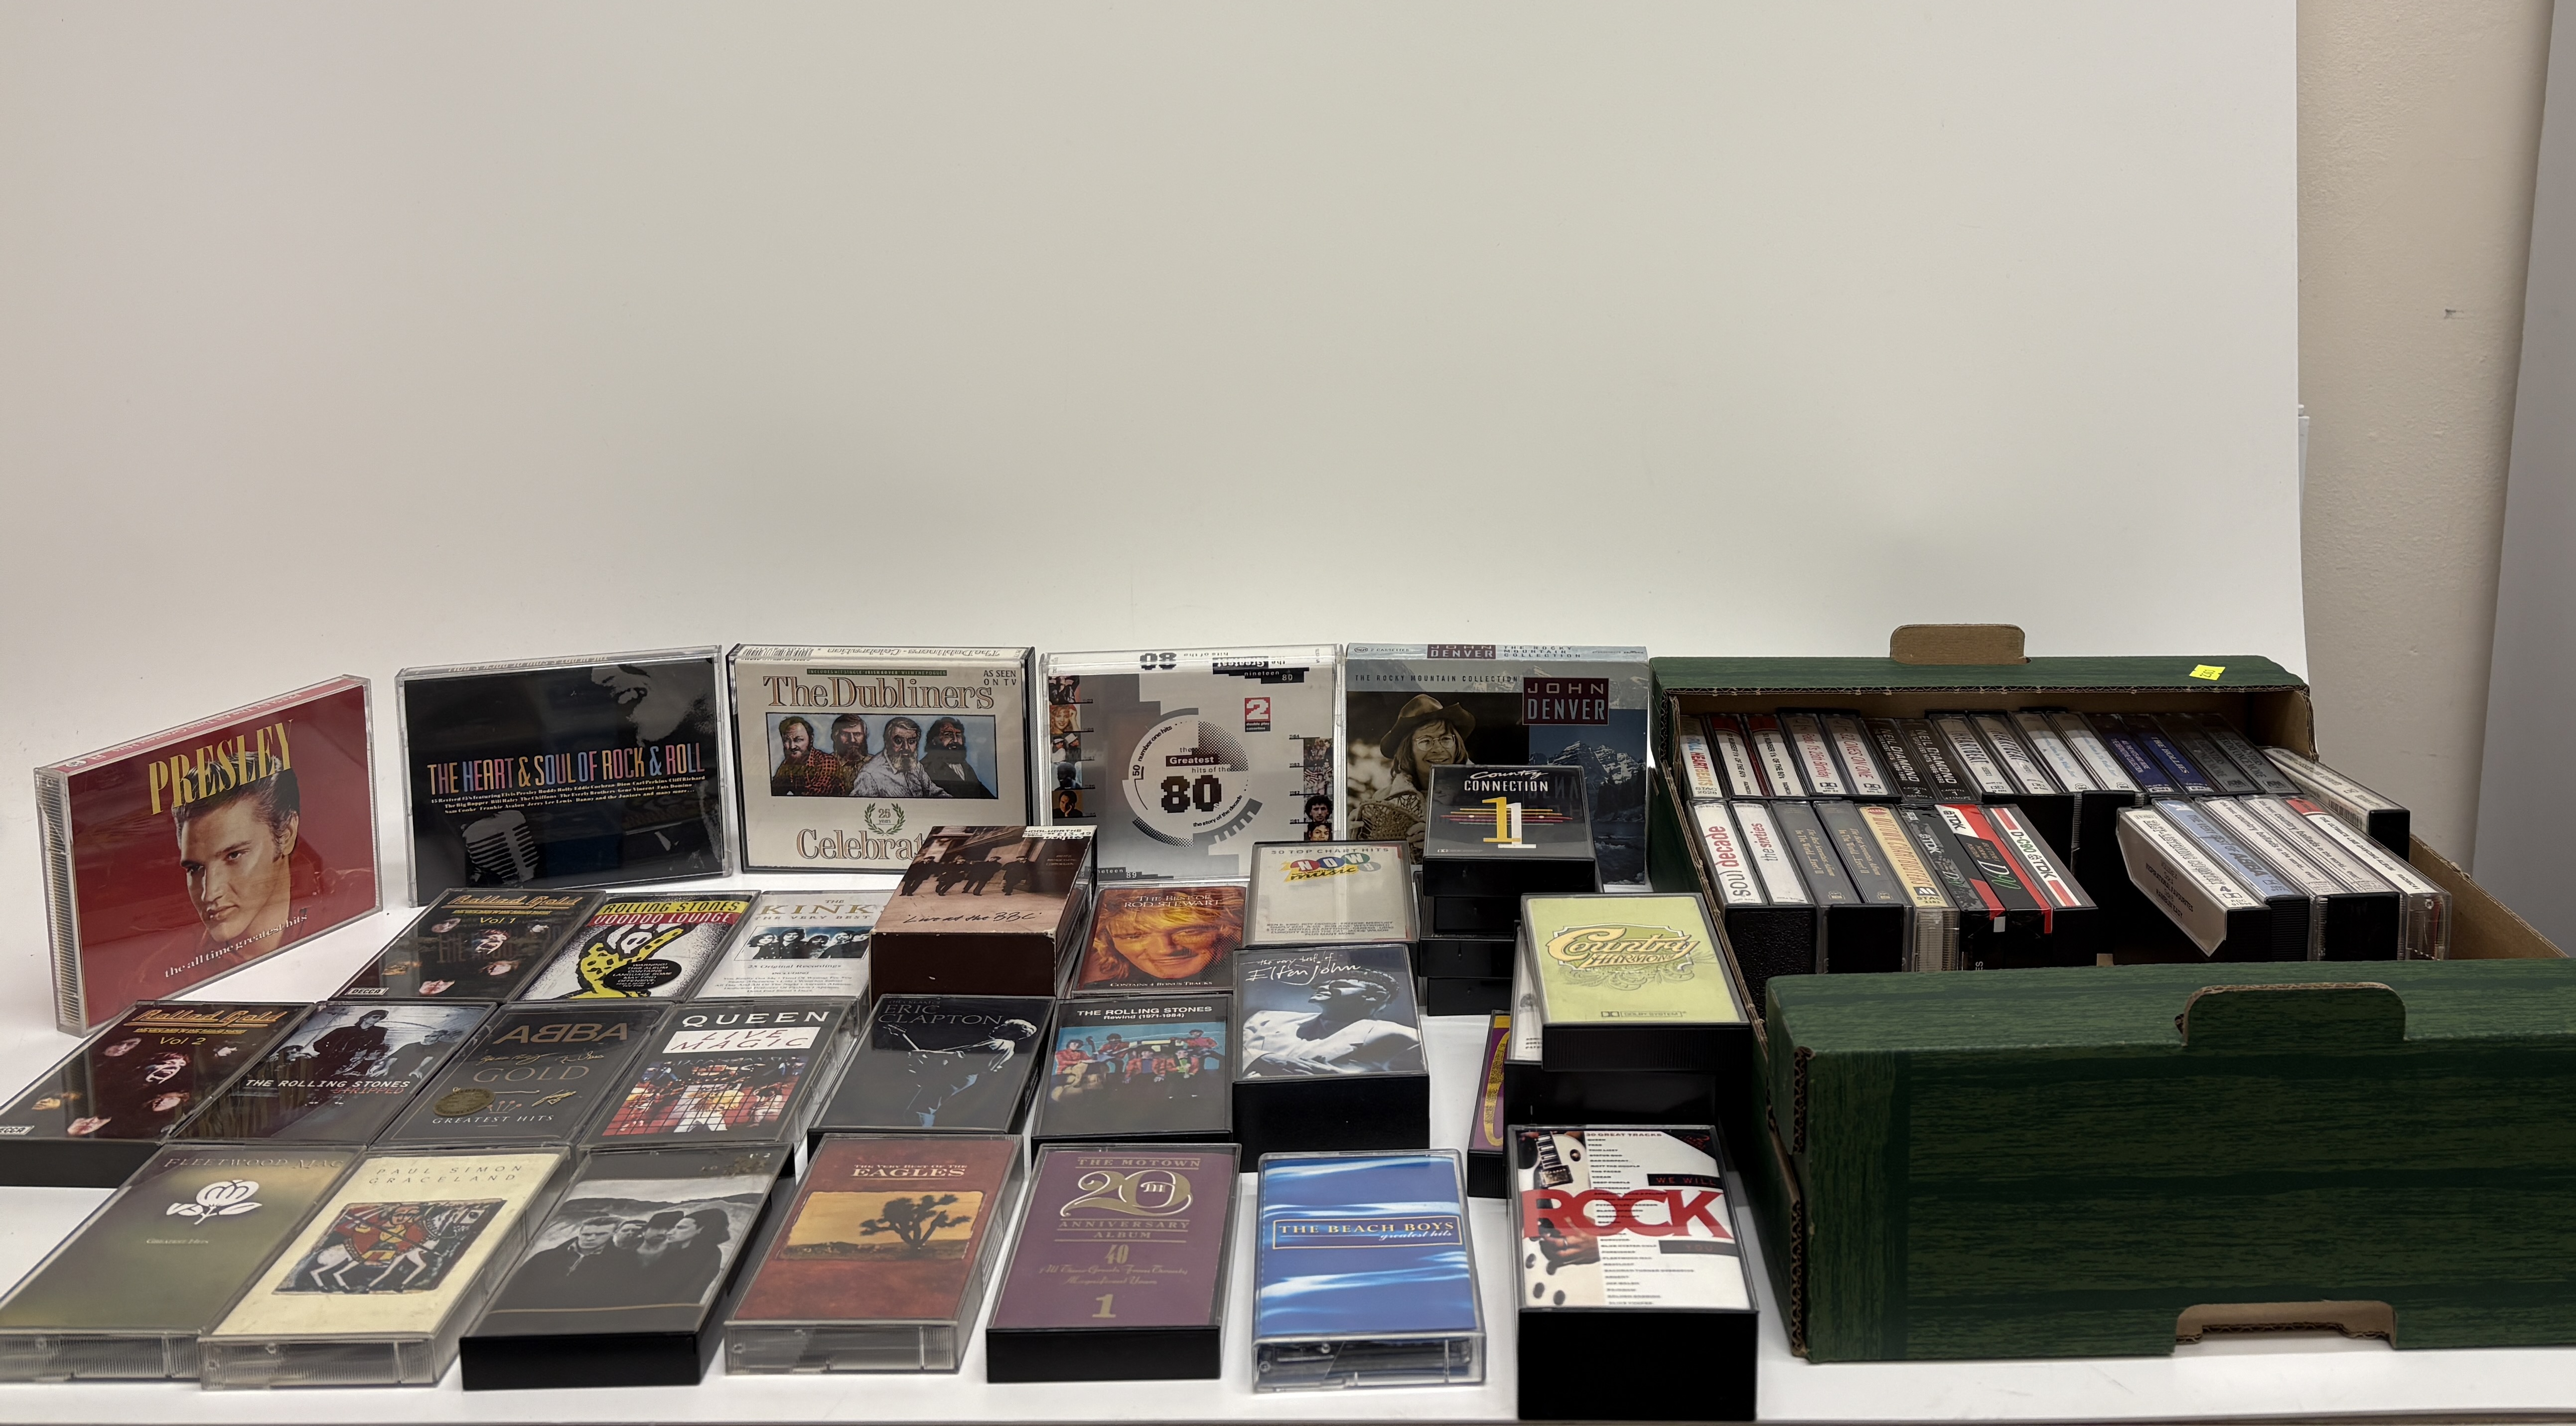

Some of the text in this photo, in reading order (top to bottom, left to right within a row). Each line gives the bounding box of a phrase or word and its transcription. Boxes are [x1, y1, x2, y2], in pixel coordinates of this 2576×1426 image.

[763, 676, 995, 709] The Dubliners
[1528, 683, 1603, 694] JOHN
[1247, 699, 1269, 720] 2
[1528, 698, 1604, 720] DENVER
[1133, 725, 1172, 776] 50 one hits
[1880, 728, 1897, 744] NEIL
[1890, 746, 1920, 782] DIAMOND
[1915, 729, 1933, 746] NEIL
[1926, 748, 1957, 784] DIAMOND
[2151, 737, 2189, 774] THE HOLLIES
[149, 719, 293, 815] PRESLEY
[427, 743, 705, 795] THE HEART & SOUL OF ROCK & ROLL
[1691, 752, 1713, 786] HEARTBEATS
[1844, 741, 1873, 779] ONES ON ONE
[1470, 770, 1549, 780] Country
[1161, 775, 1222, 813] 80
[1464, 781, 1548, 792] CONNECTION
[1229, 795, 1242, 811] decade
[878, 808, 891, 819] 25
[1946, 814, 1966, 830] TDK
[1872, 817, 1905, 842] MOTOWN
[2235, 814, 2279, 848] country ballads
[2274, 813, 2320, 848] country ballads
[1750, 823, 1778, 861] the sixties
[1922, 838, 1942, 854] TDK
[1297, 853, 1363, 871] NOW
[1705, 825, 1751, 896] soul decade
[1888, 842, 1932, 886] CHARTBUSTERS
[2032, 859, 2057, 878] TDK
[2229, 852, 2269, 877] ABBA
[1290, 866, 1357, 881] music
[447, 895, 583, 909] Rolled Gold
[603, 901, 741, 913] ROLLING STONES
[593, 912, 732, 925] VOODOO LOUNGE
[165, 915, 307, 978] the all time greatest hits
[1546, 928, 1700, 964] Country
[1246, 965, 1309, 981] Elton
[132, 1009, 287, 1027] Rolled Gold
[884, 1005, 940, 1014] ERIC
[682, 1011, 830, 1028] QUEEN
[878, 1014, 1004, 1025] CLAPTON
[493, 1023, 627, 1044] ABBA
[702, 1030, 788, 1040] LIVE
[671, 1038, 808, 1050] MAGIC
[473, 1066, 589, 1082] GOLD
[278, 1080, 347, 1088] ROLLING
[432, 1116, 510, 1124] GREATEST
[163, 1158, 343, 1169] FLEETWOOD MAC
[449, 1165, 523, 1174] SIMON
[1122, 1158, 1200, 1167] MOTOWN
[369, 1174, 517, 1185] GRACELAND
[851, 1168, 966, 1177] EAGLES
[1060, 1170, 1193, 1217] 20
[1521, 1189, 1734, 1239] ROCK
[1059, 1220, 1190, 1229] ANNIVERSARY
[1279, 1222, 1454, 1234] THE BEACH BOYS
[1379, 1231, 1429, 1242] greatest
[1105, 1245, 1129, 1265] 40
[1092, 1294, 1116, 1318] 1
